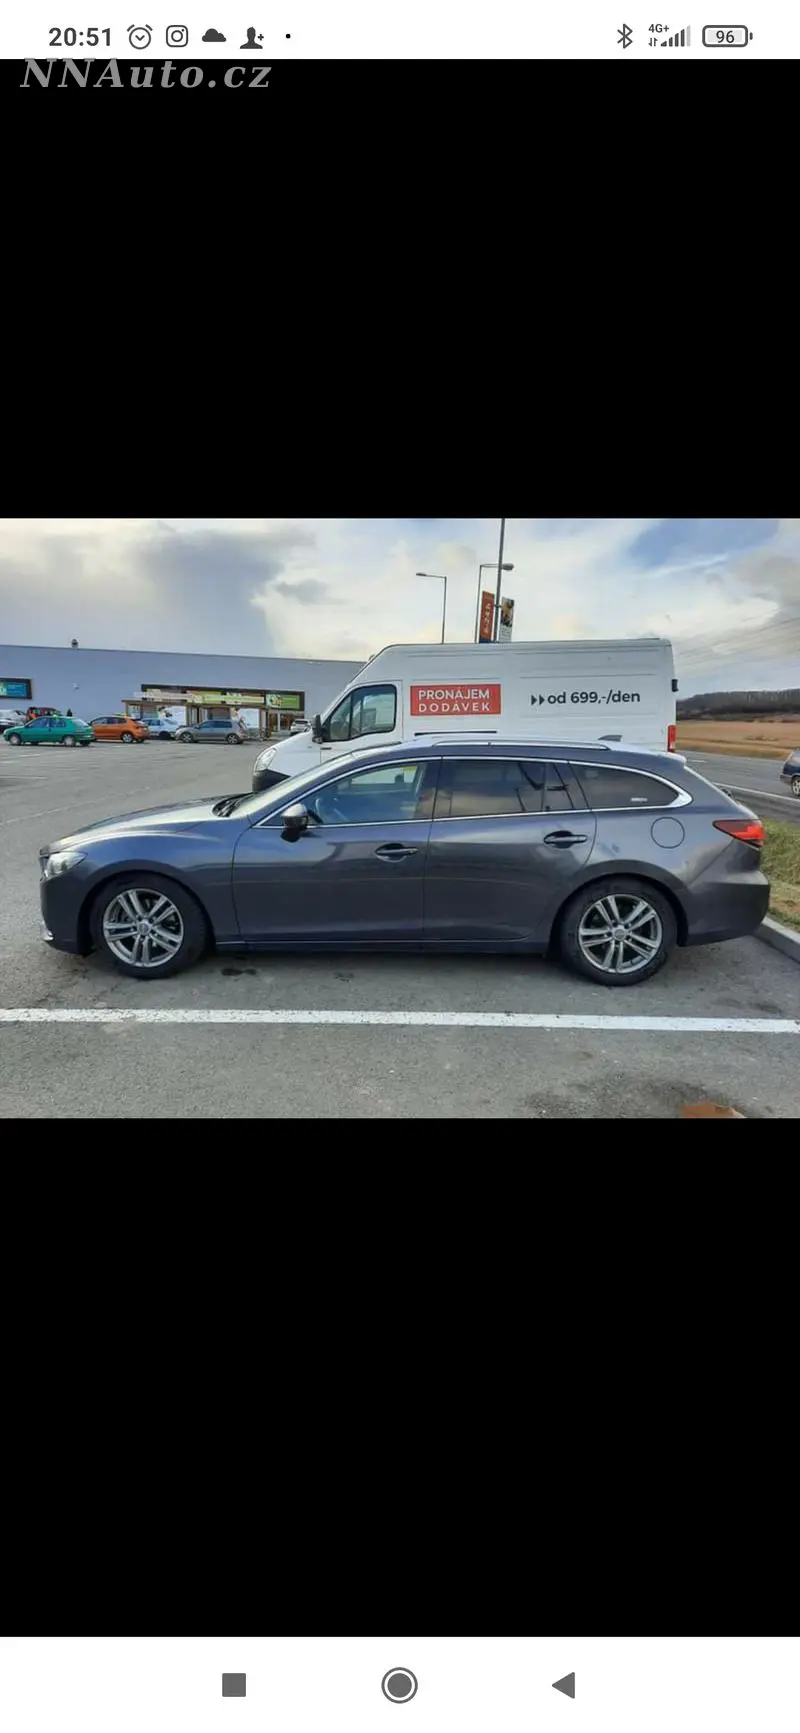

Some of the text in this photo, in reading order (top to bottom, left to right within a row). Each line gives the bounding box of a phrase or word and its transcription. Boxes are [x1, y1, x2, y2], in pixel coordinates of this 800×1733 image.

[418, 687, 490, 700] PRONÁJEM
[547, 689, 641, 705] od 699,-/den
[418, 701, 490, 713] DODÁVEK
